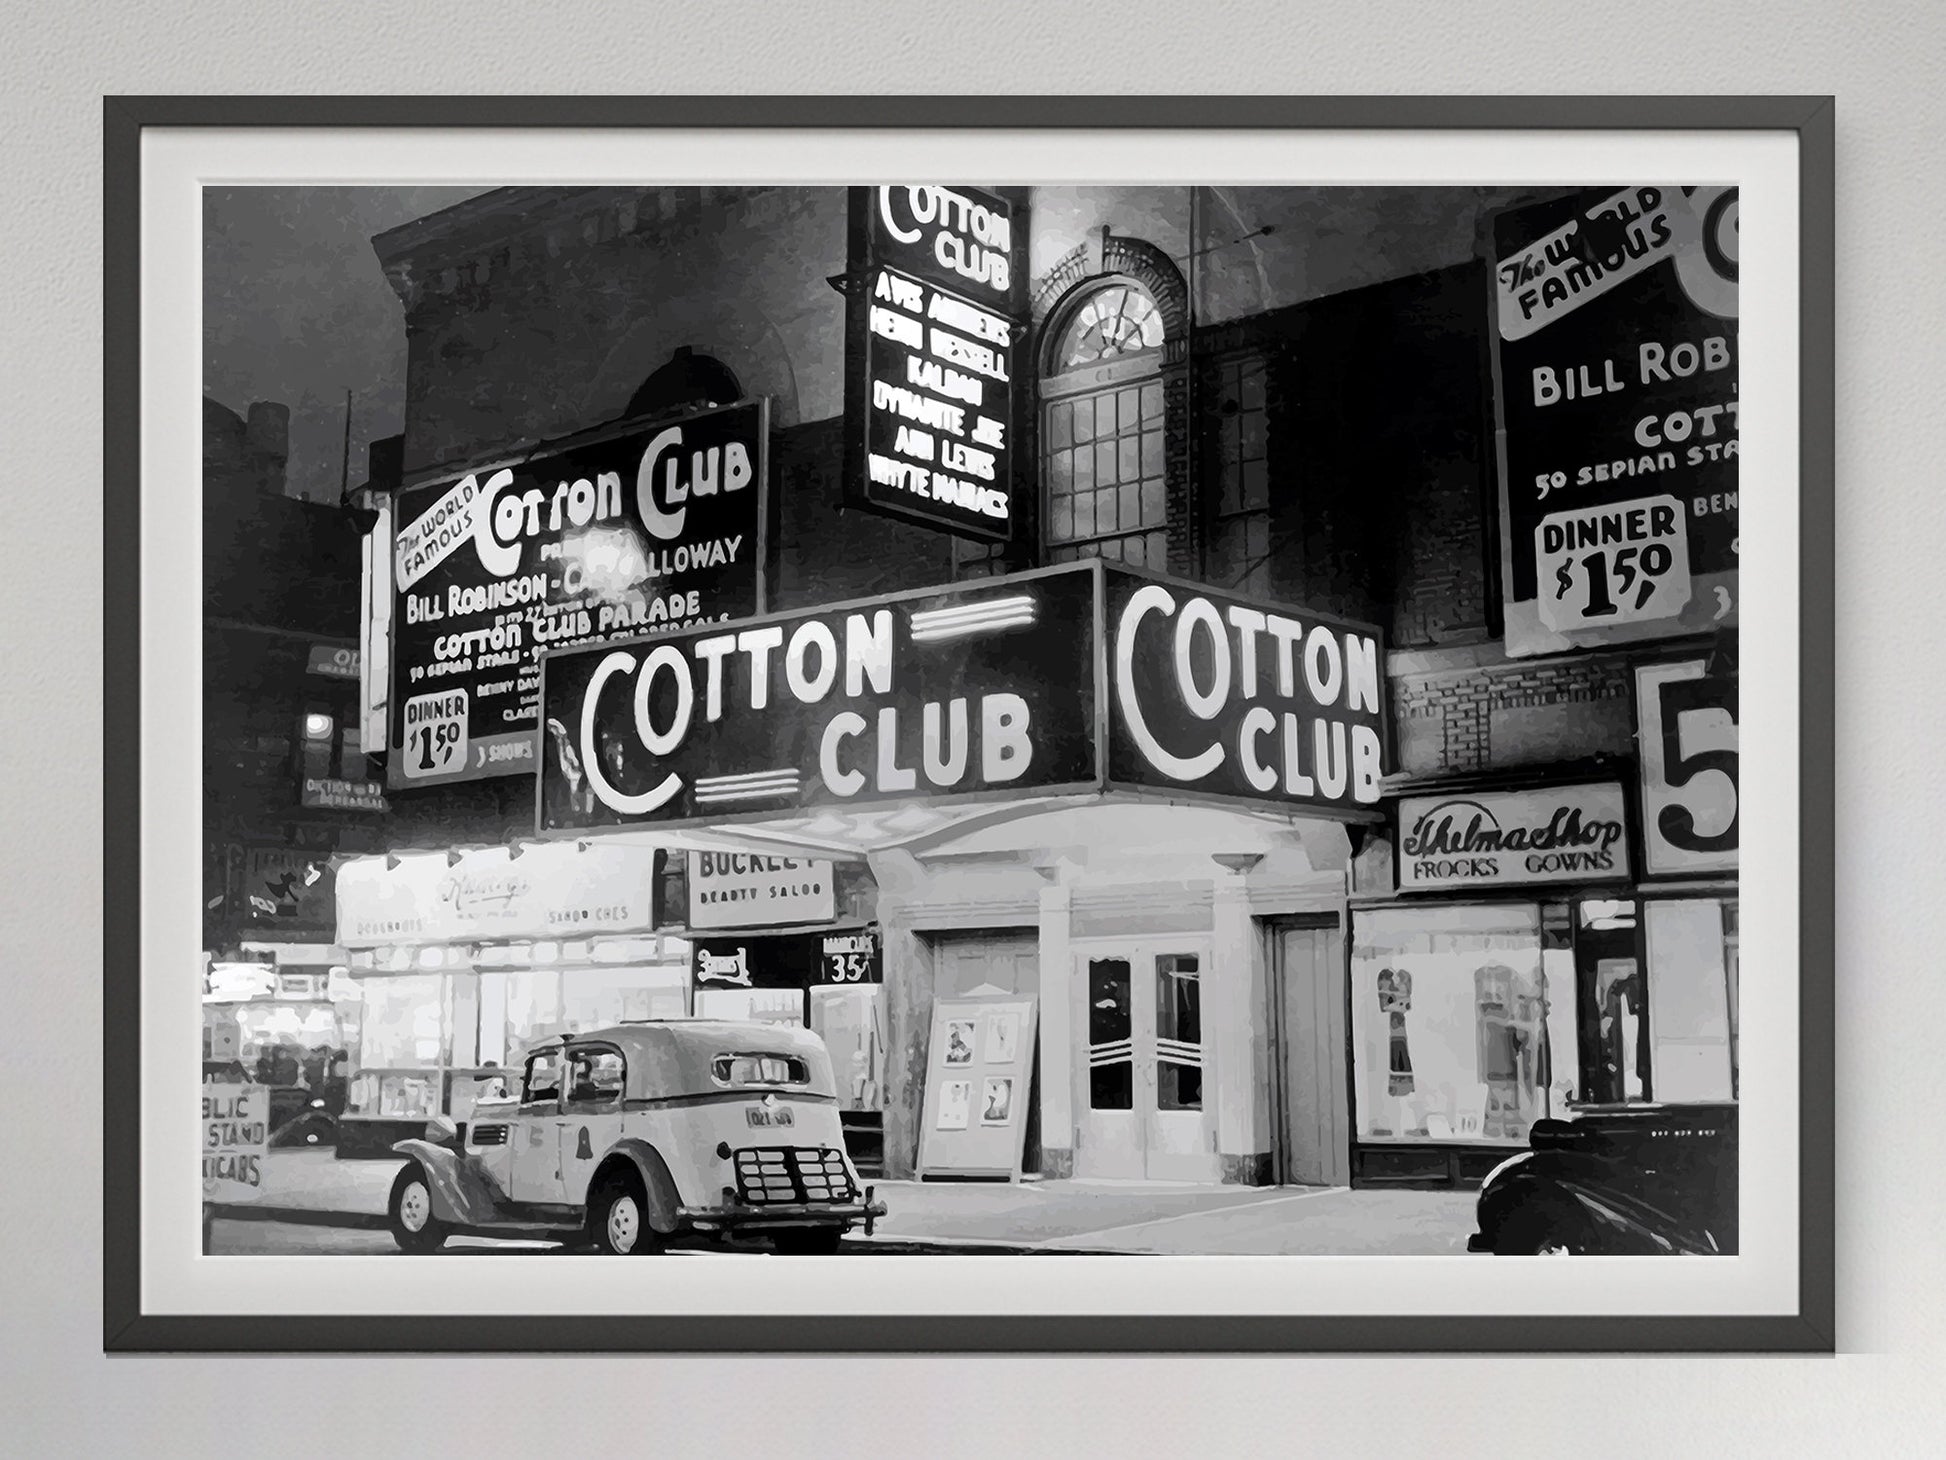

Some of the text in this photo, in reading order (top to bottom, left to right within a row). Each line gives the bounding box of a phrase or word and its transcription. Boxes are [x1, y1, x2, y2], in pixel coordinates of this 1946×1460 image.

[935, 230, 1010, 291] CLUB
[1518, 214, 1672, 320] FAMOUS
[1533, 336, 1739, 407] BILL ROB
[637, 426, 752, 539] CLUB
[1535, 471, 1567, 500] 50
[1576, 452, 1676, 485] SEPIAN
[404, 510, 473, 577] FAMOUS
[420, 485, 474, 539] WORLD
[1543, 505, 1676, 554] DINNER
[407, 594, 445, 625] BILL
[448, 573, 547, 618] ROBINSON
[433, 623, 522, 661] COTTON
[532, 611, 591, 643] CLUB
[598, 591, 700, 632] PARADE
[408, 695, 465, 725] DINNER
[581, 609, 893, 814] COTTON
[1114, 585, 1380, 781] COTTON
[820, 692, 1034, 796] CLUB
[1239, 706, 1382, 803] CLUB
[1414, 857, 1500, 879] FROCKS
[1525, 851, 1615, 874] GOWNS
